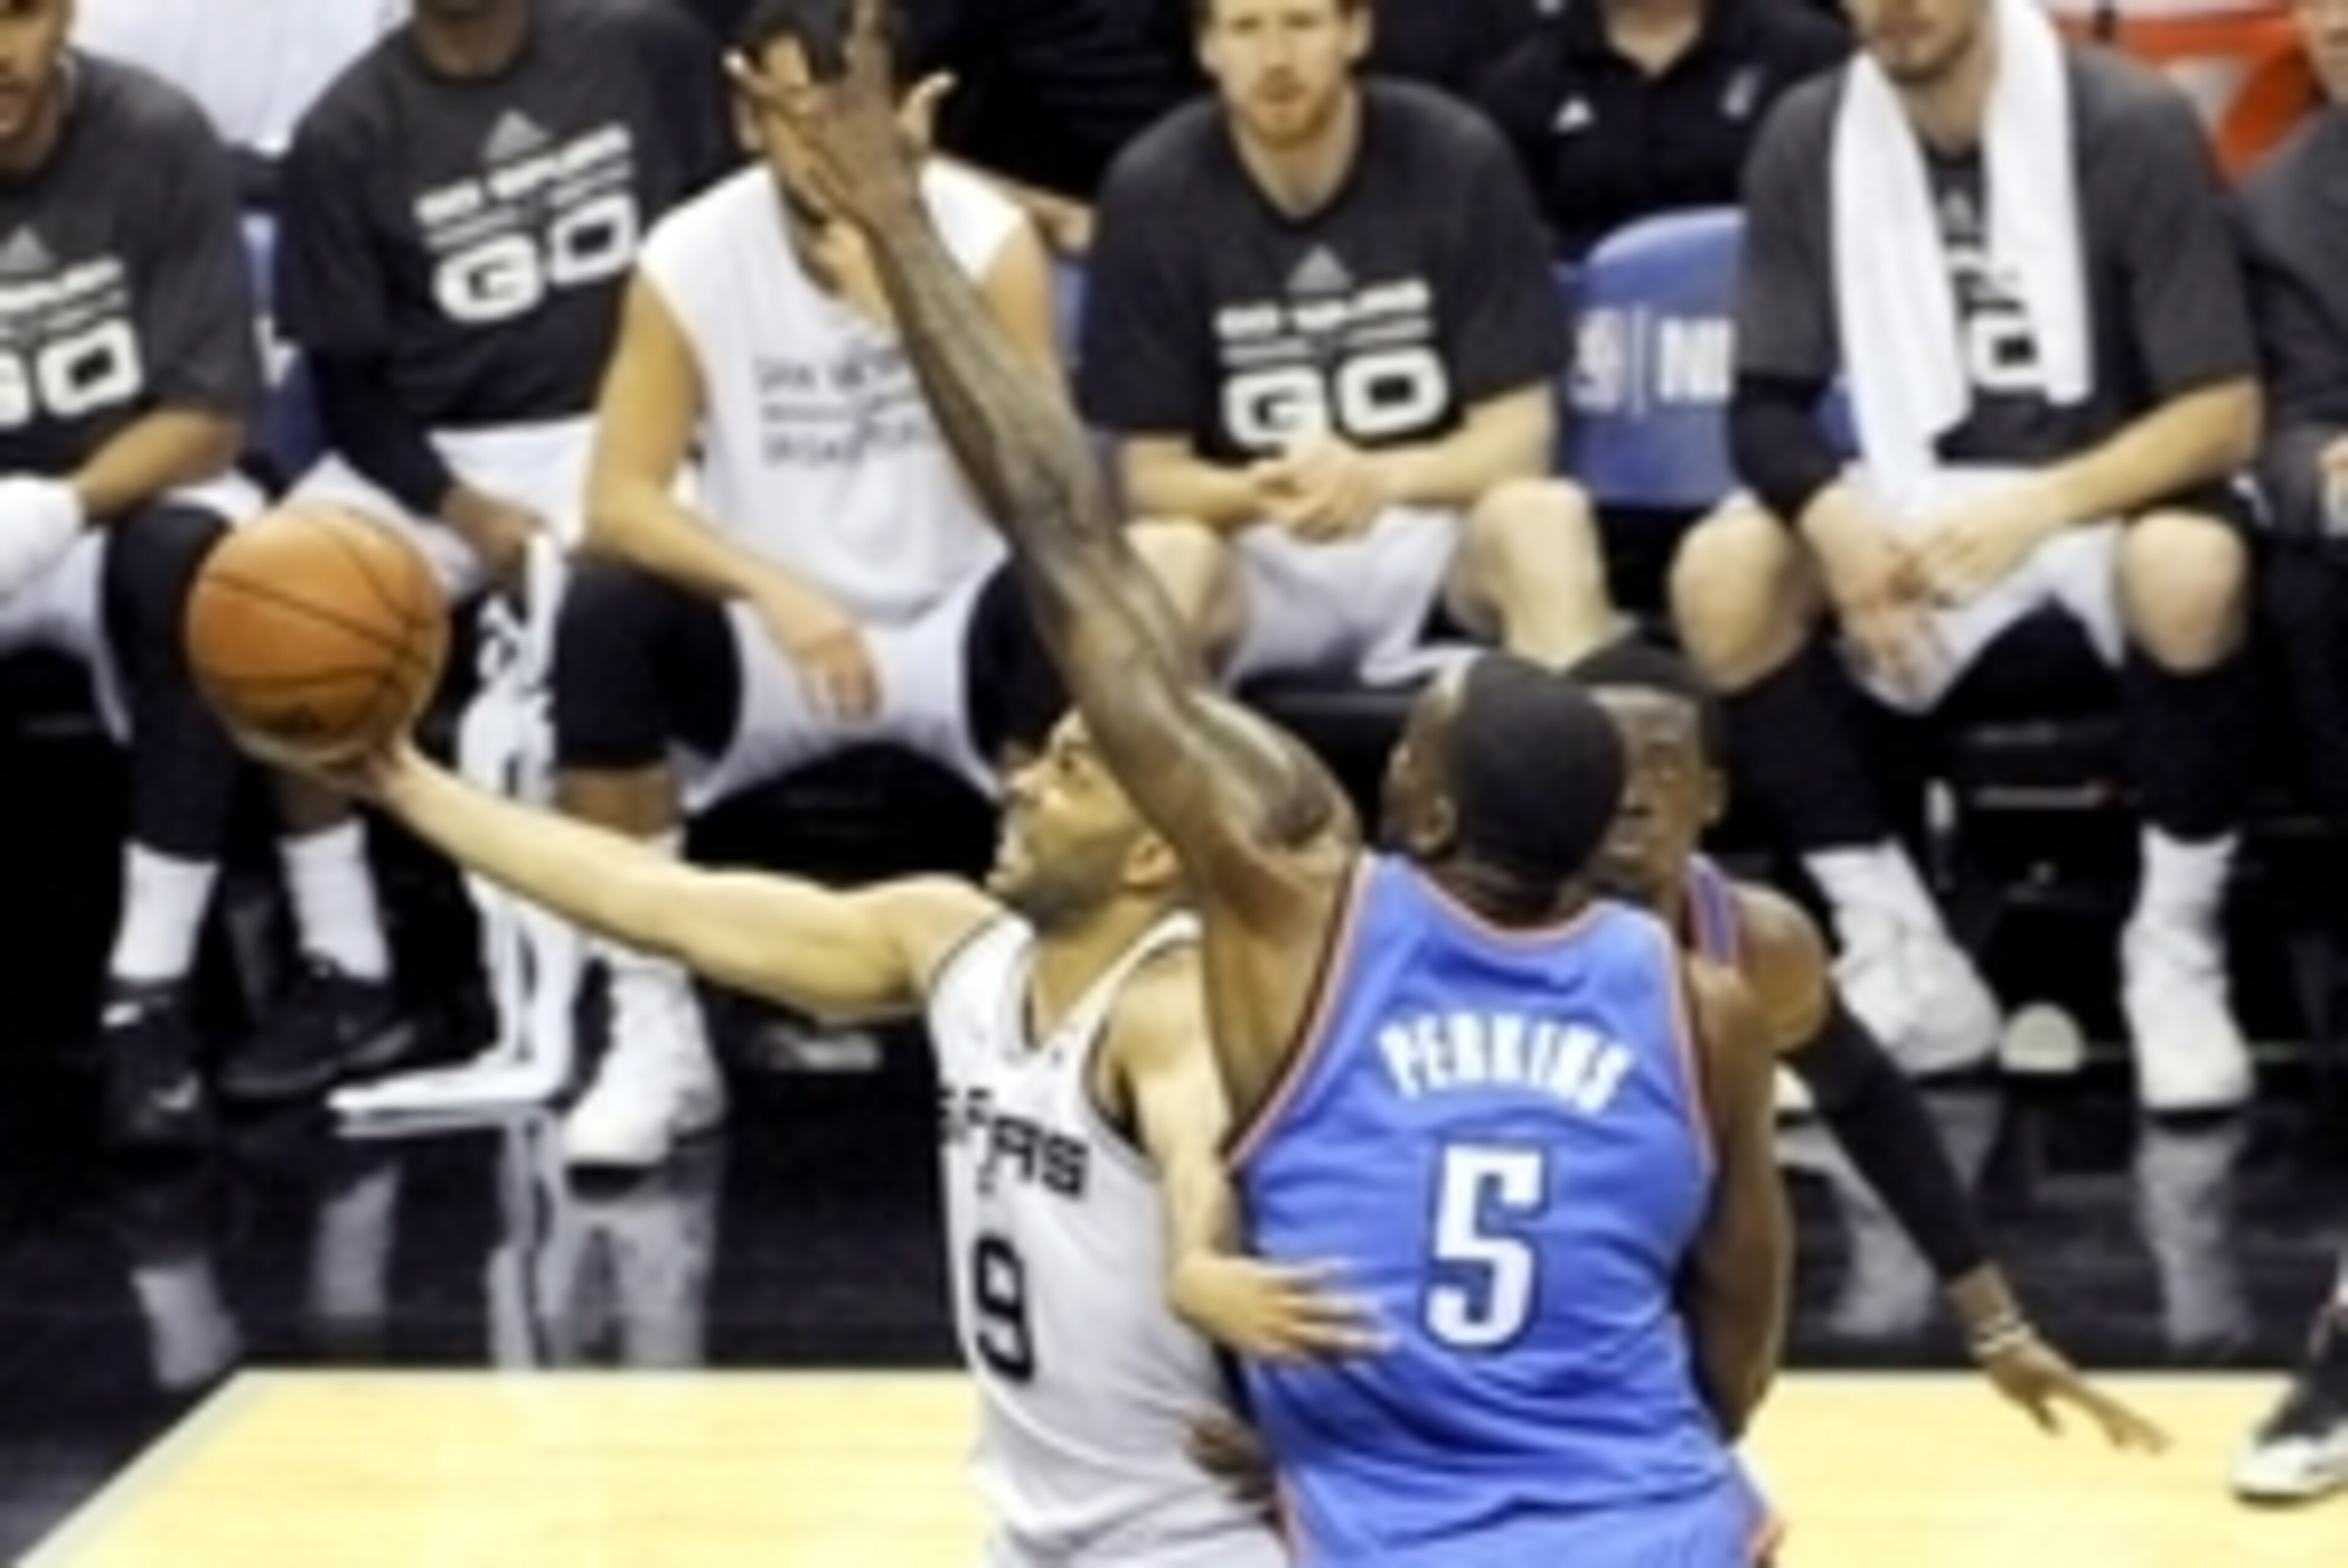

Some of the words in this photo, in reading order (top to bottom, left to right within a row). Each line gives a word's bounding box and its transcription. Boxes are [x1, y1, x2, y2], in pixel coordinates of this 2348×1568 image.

[433, 194, 637, 323] GO
[1224, 345, 1447, 449] GO
[1377, 1012, 1634, 1115] PERKINS
[974, 1233, 1035, 1385] 9
[1425, 1144, 1545, 1347] 5
